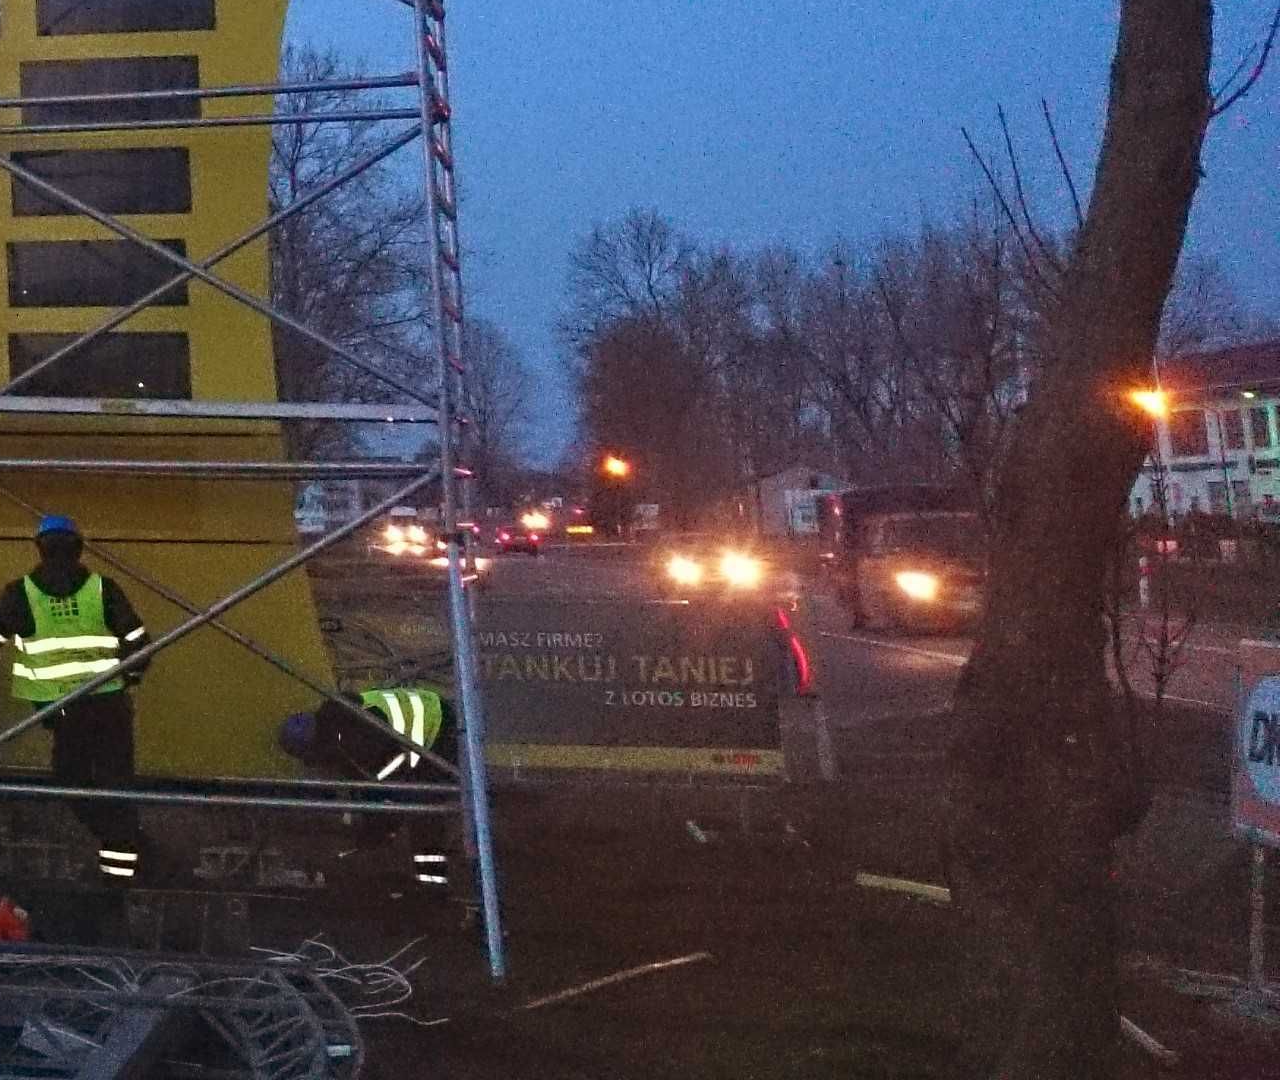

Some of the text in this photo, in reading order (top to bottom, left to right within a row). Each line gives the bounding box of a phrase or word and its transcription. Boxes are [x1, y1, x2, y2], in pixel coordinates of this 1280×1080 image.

[631, 655, 754, 684] TANIEJ
[605, 691, 758, 708] Z LOTOS BIZNES
